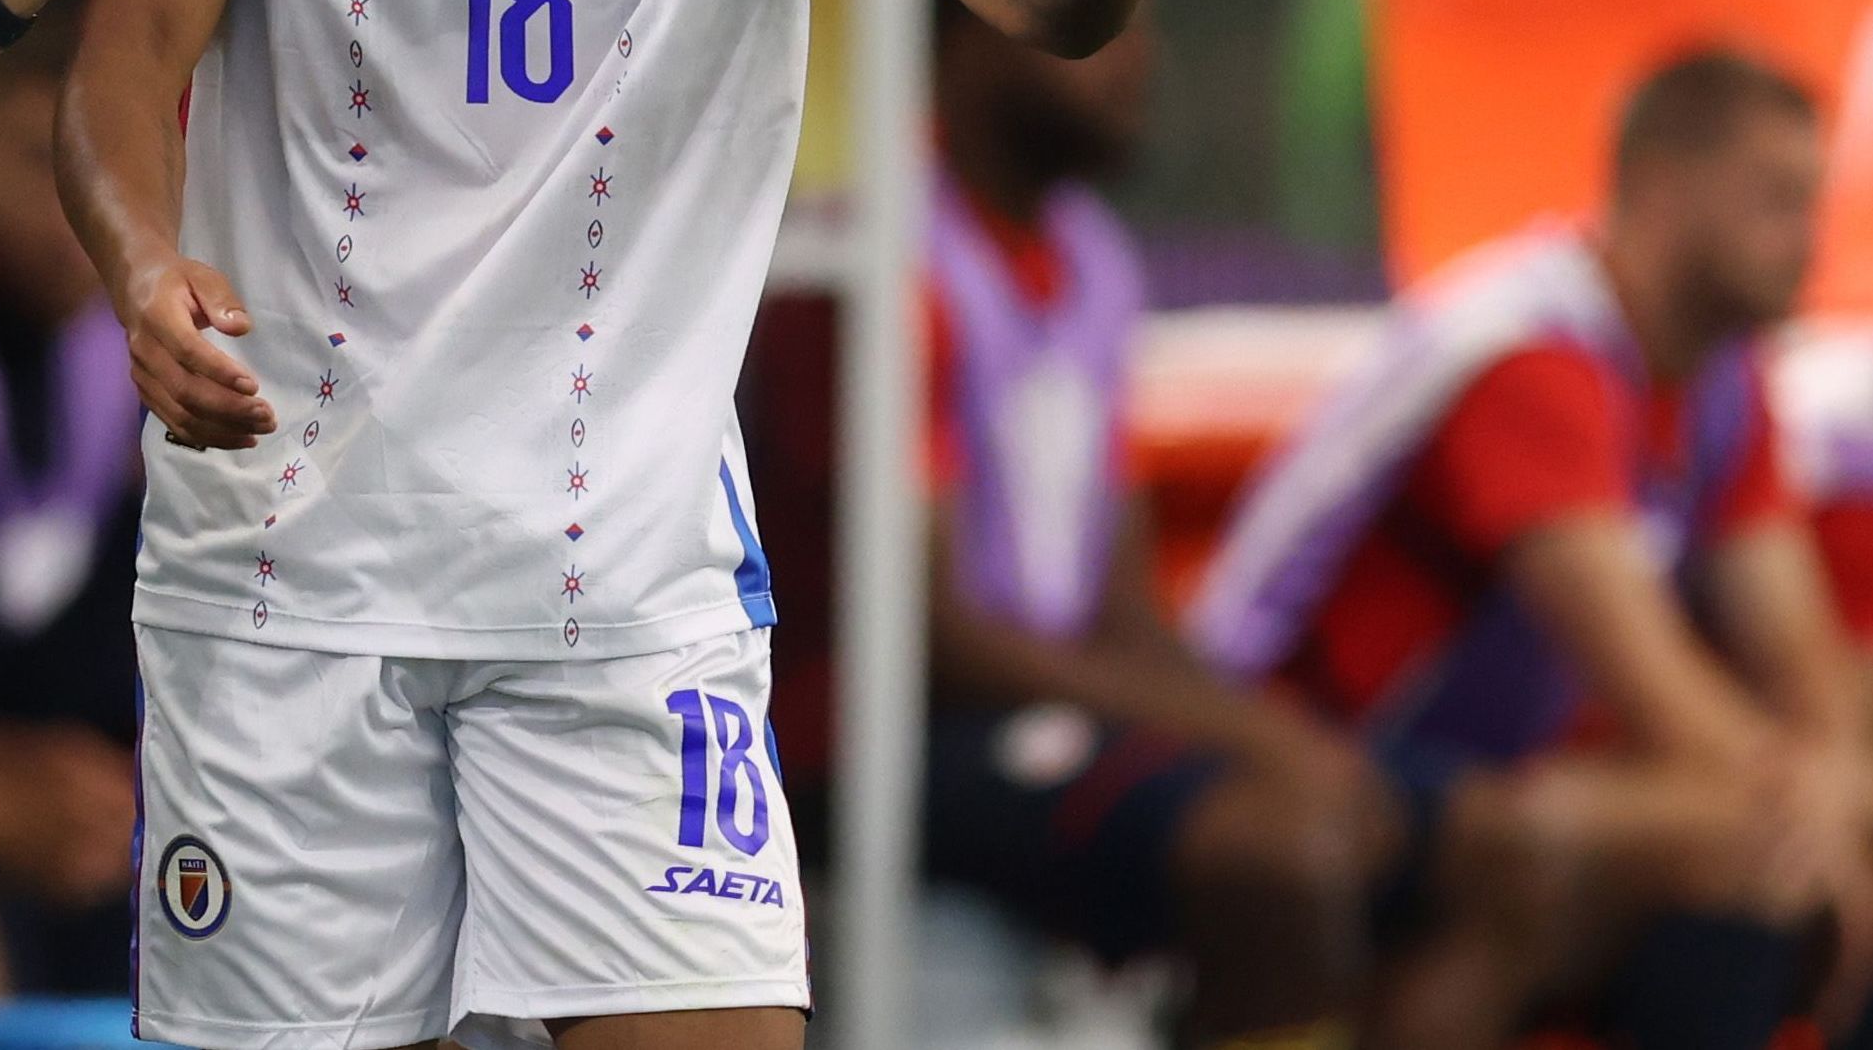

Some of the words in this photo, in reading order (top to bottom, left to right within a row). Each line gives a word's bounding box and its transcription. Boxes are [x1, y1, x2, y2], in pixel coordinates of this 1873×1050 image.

[665, 689, 769, 857] 18
[181, 861, 204, 869] HAITI
[645, 866, 784, 909] SAETA
